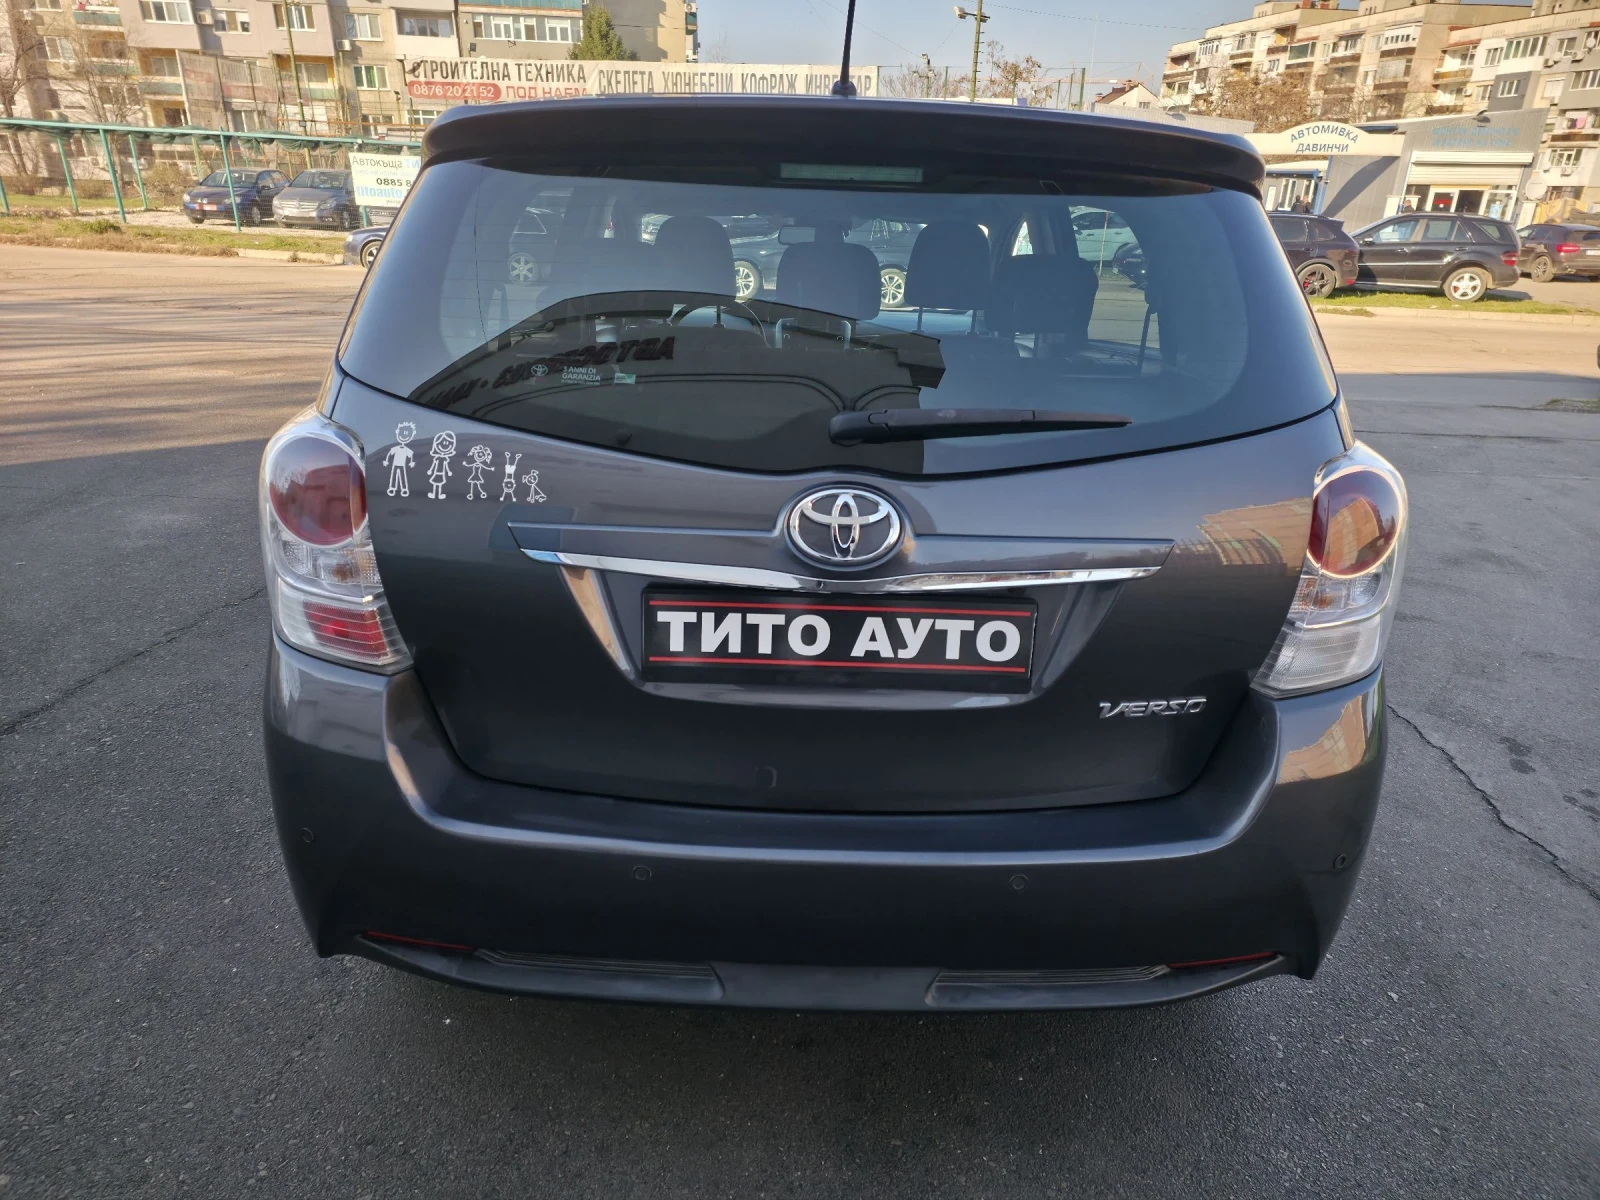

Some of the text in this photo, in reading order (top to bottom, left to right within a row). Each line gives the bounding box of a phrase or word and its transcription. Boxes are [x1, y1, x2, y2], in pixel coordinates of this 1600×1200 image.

[412, 60, 587, 83] СТРОИТЕЛНА ТЕХНИКА
[741, 72, 798, 95] КОФРАЖ
[413, 84, 495, 98] 0876 20 21 52
[506, 86, 537, 99] ПОД
[1290, 125, 1359, 143] АВТОМИВКА
[1296, 143, 1349, 154] ДАВИНЧИ
[352, 156, 402, 170] Автокъща
[376, 178, 403, 187] 0885
[562, 372, 601, 381] GARANZIA
[657, 611, 1021, 662] ТИТО АУТО
[1099, 696, 1207, 718] VERSO
